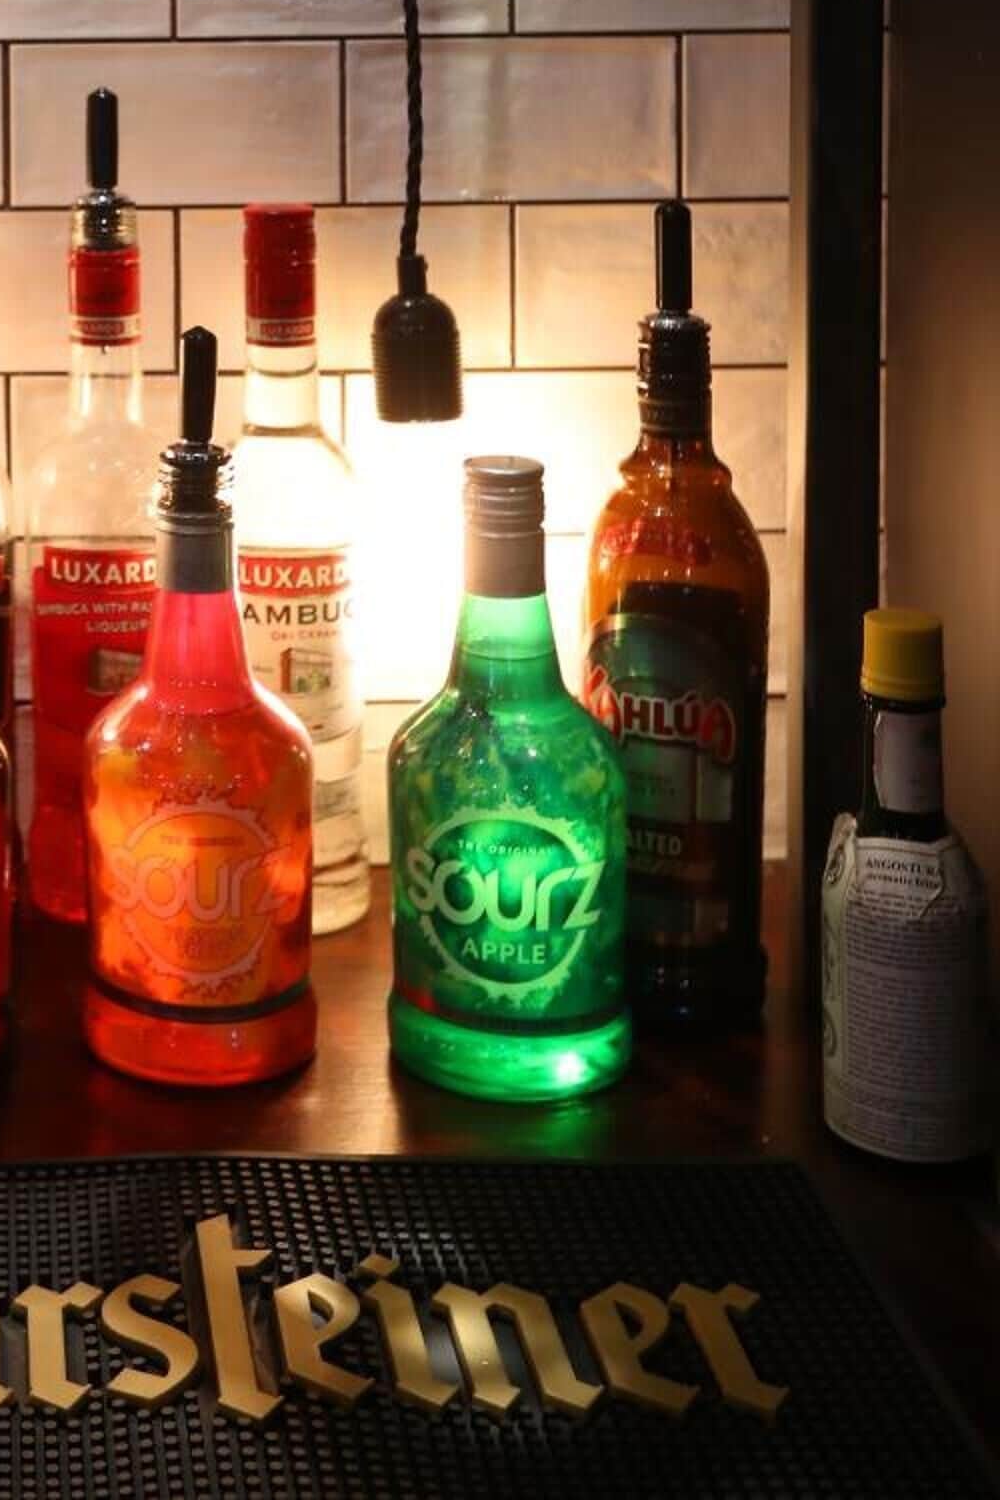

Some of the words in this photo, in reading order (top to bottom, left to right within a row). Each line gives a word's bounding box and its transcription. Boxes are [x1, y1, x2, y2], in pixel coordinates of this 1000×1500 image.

[51, 557, 157, 584] LUXARD
[239, 563, 346, 588] LUXARD
[243, 598, 352, 625] AMBUC
[626, 831, 682, 856] ALTED
[463, 938, 546, 965] APPLE
